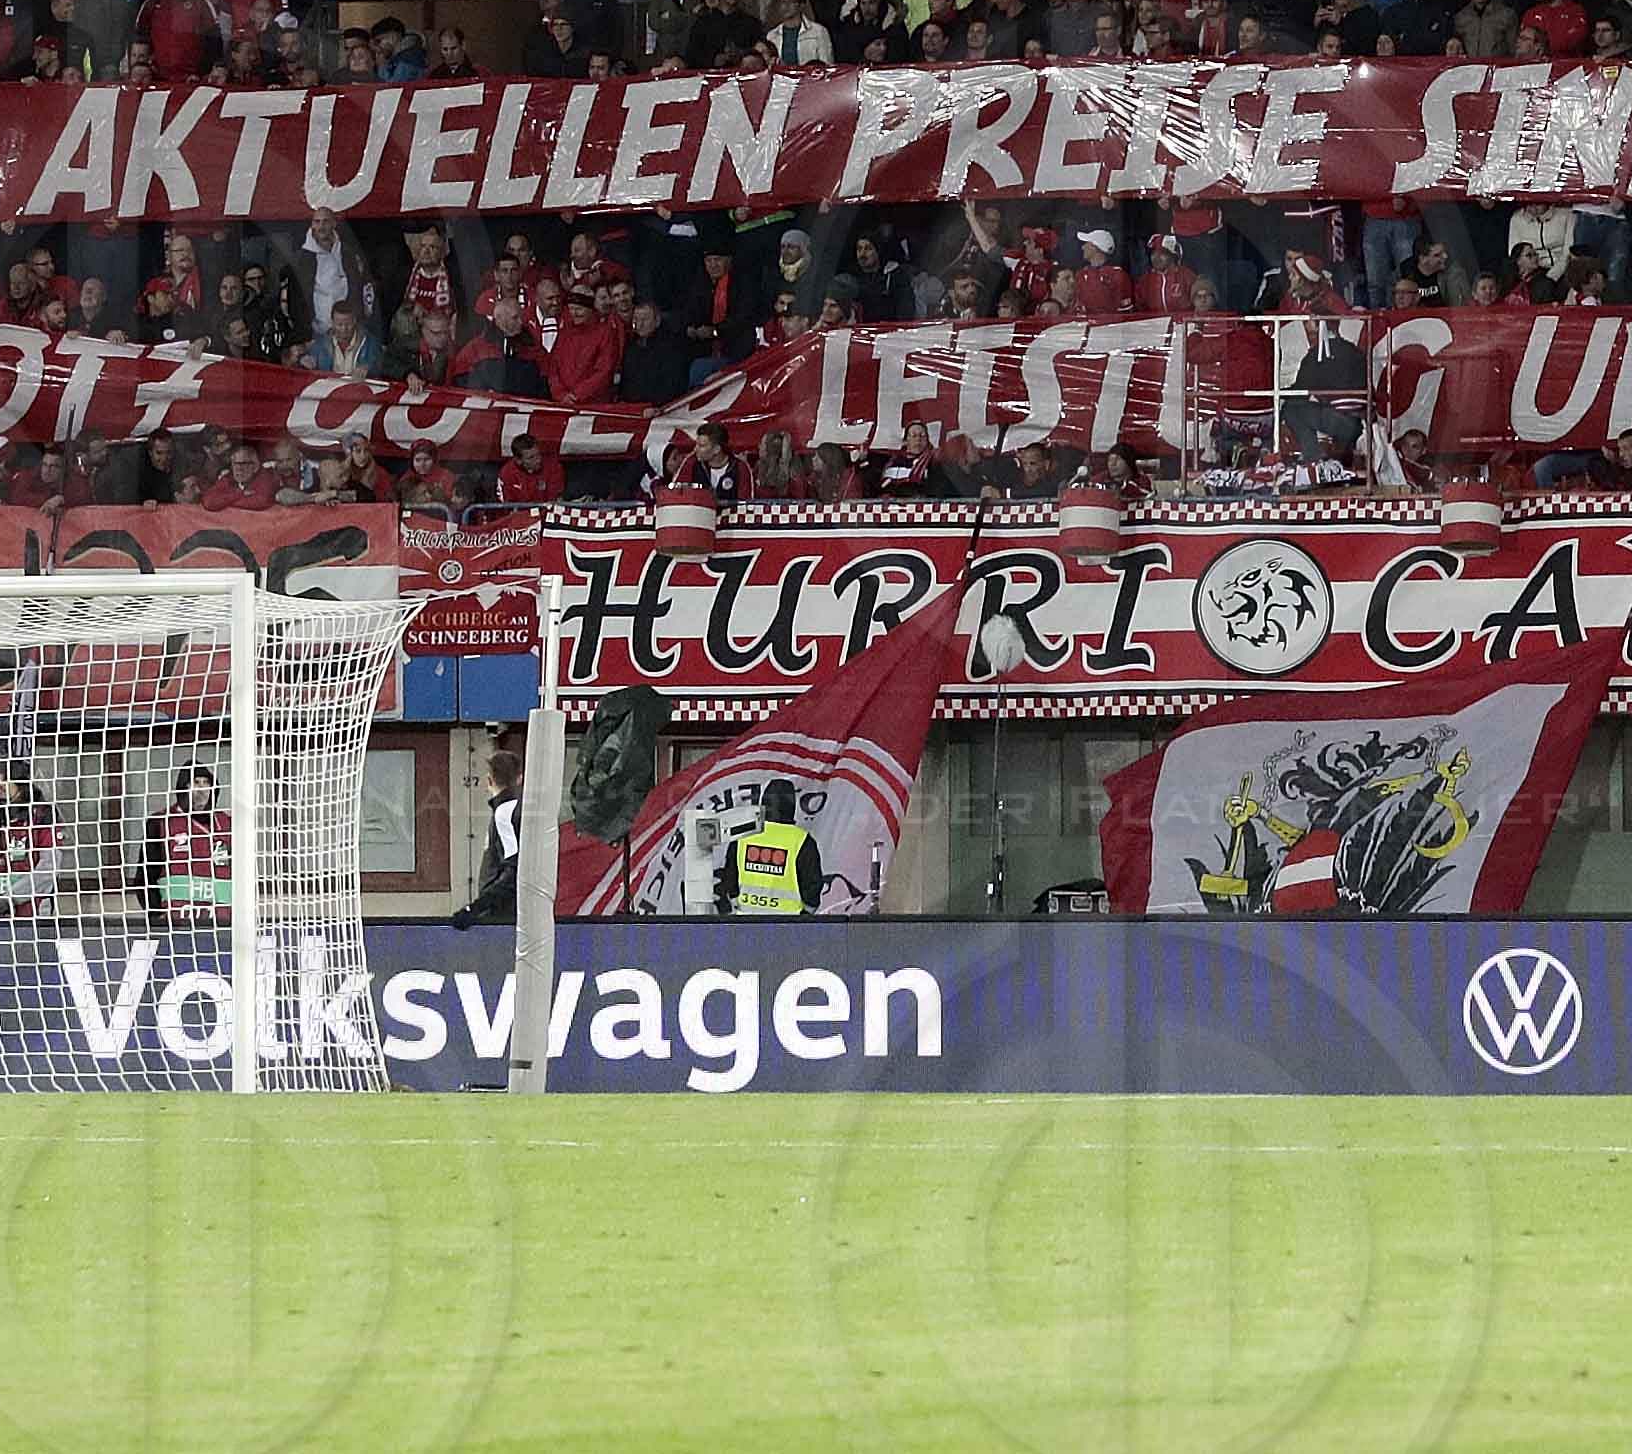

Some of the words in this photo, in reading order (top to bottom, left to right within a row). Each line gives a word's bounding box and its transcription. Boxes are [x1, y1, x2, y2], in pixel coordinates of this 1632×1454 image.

[24, 74, 800, 218] AKTUELLEN
[842, 62, 1349, 199] PREISE
[813, 315, 1455, 453] LEISTG
[406, 628, 530, 645] SCHNEEBERG
[510, 615, 529, 626] AM
[740, 893, 780, 909] 3355
[55, 934, 944, 1094] Volkswagen
